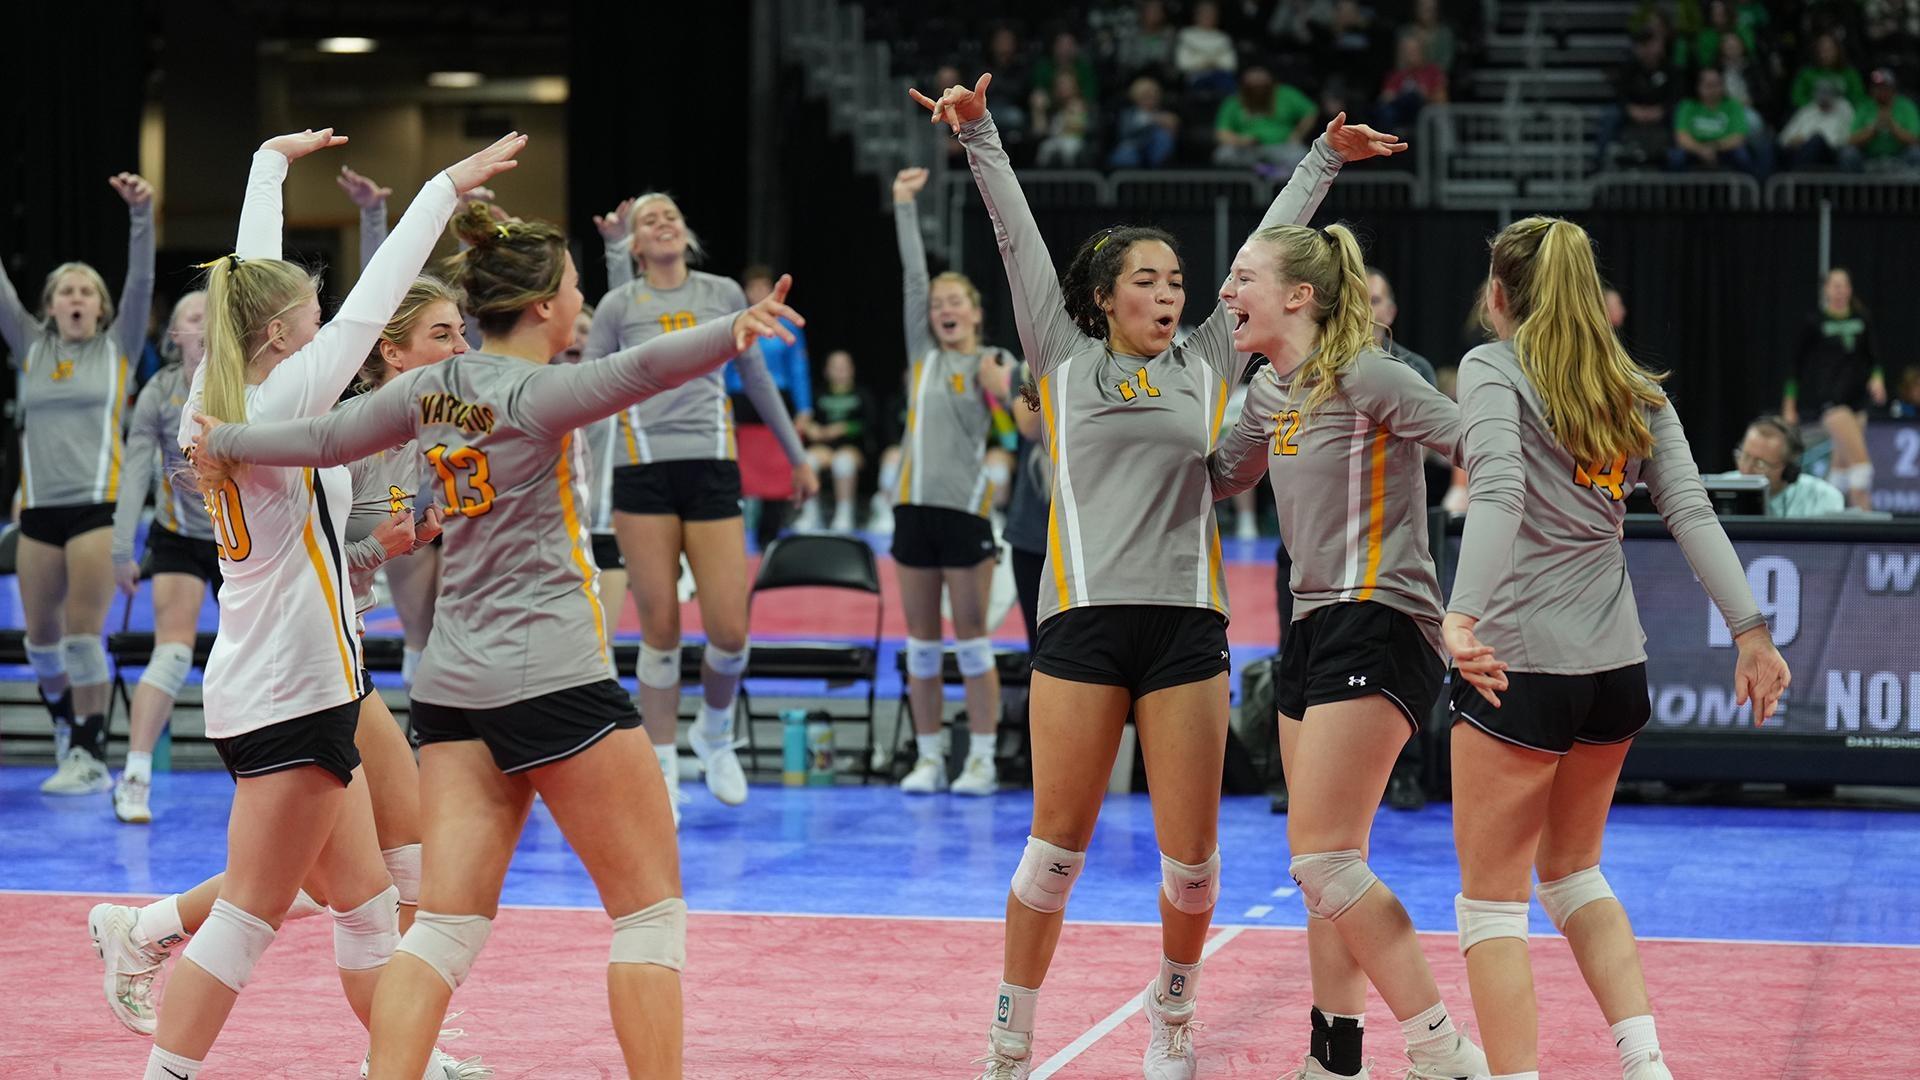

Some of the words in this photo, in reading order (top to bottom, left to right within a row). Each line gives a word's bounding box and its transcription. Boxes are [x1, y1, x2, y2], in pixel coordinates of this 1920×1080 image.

[1272, 410, 1300, 456] 12
[424, 443, 497, 519] 13
[1648, 684, 1791, 728] OM
